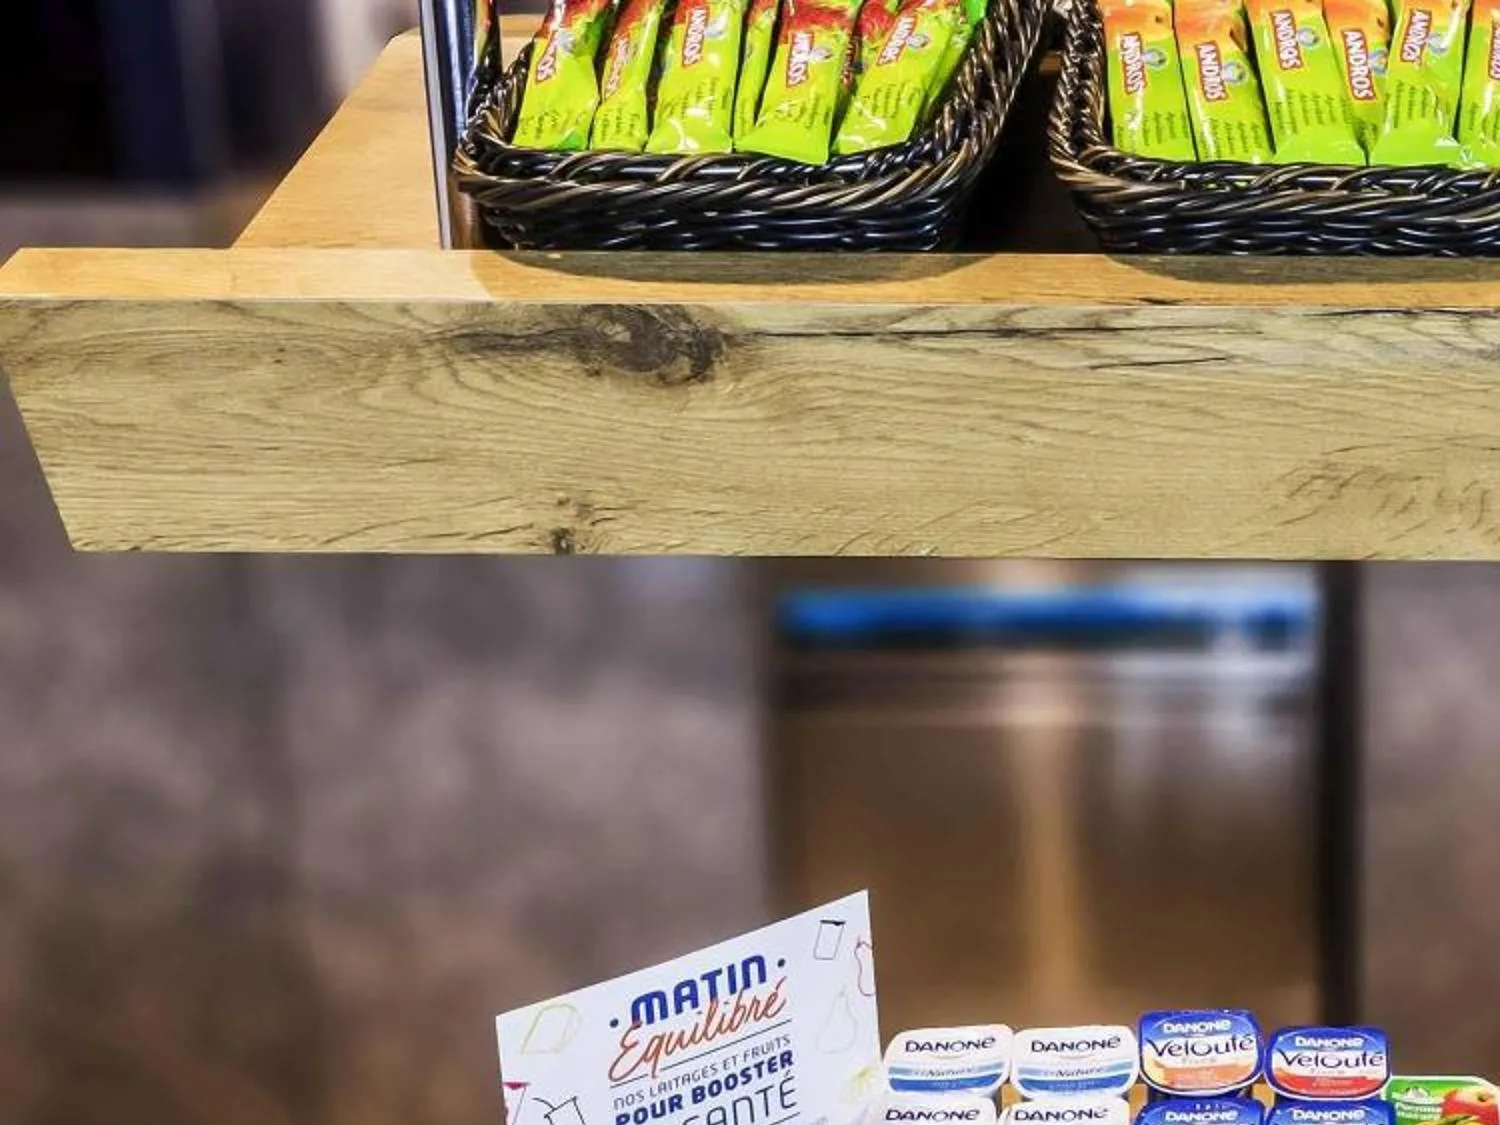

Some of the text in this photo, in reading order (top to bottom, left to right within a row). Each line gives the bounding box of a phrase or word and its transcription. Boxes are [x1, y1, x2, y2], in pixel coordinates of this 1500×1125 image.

[1344, 30, 1374, 99] ANDROS
[629, 954, 768, 1027] MATIN
[1163, 1019, 1232, 1034] DANONE
[905, 1036, 997, 1054] DANONE
[1031, 1036, 1122, 1054] DANONE
[1145, 1034, 1255, 1058] Velouté
[1295, 1036, 1365, 1049] DANONE
[649, 1063, 719, 1096] LAITAGES
[723, 1056, 741, 1072] ET
[743, 1034, 792, 1066] FRUITS
[1277, 1048, 1384, 1069] Velouté
[691, 1049, 795, 1103] BOOSTER
[885, 1107, 981, 1122] DANONE
[1165, 1109, 1239, 1122] DANONE
[1292, 1108, 1365, 1121] DANONE
